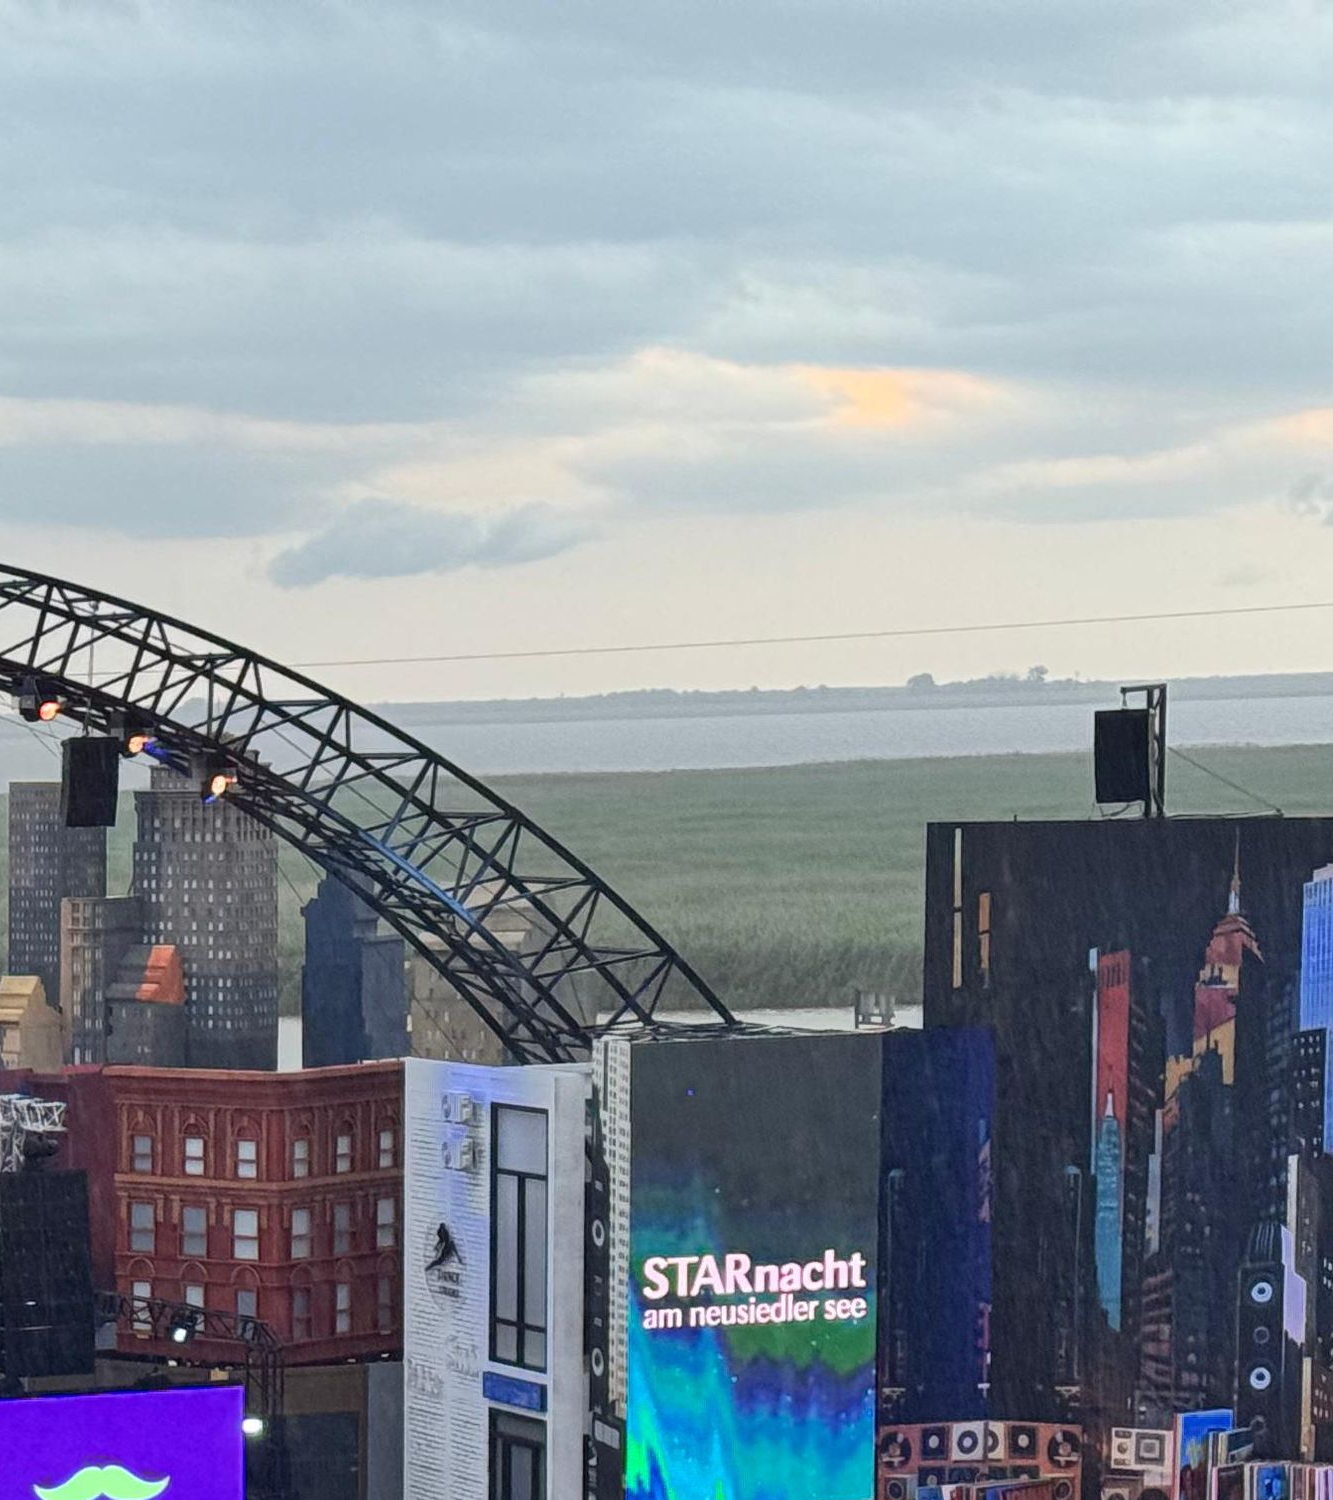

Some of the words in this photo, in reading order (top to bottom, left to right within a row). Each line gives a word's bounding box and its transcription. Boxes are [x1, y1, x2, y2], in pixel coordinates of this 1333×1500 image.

[643, 1249, 867, 1299] STARnacht
[642, 1308, 682, 1329] am
[689, 1294, 819, 1327] neusiedler
[824, 1298, 867, 1320] see
